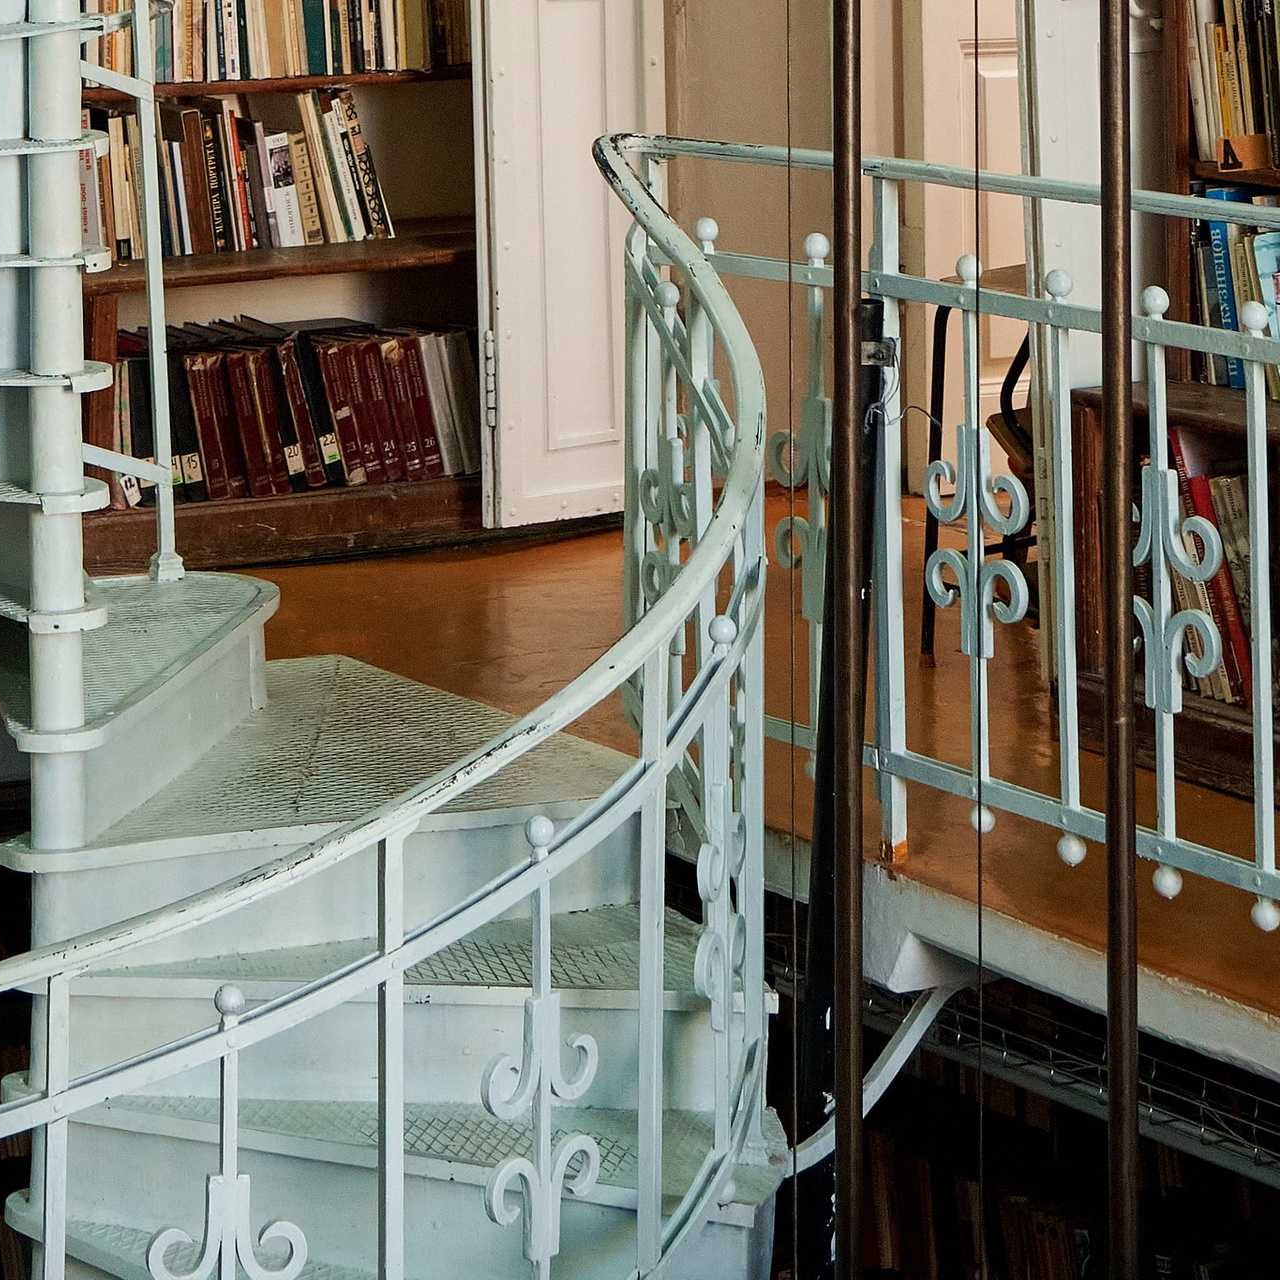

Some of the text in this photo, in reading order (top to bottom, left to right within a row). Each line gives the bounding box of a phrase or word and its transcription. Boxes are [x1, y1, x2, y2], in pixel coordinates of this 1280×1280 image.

[206, 142, 226, 234] МАСТЕРА ПОРТРЕТА
[1209, 228, 1232, 325] КУЗНЕЦОВ
[322, 435, 336, 447] 22
[424, 436, 436, 448] 26
[287, 445, 301, 458] 20
[185, 459, 198, 470] 15
